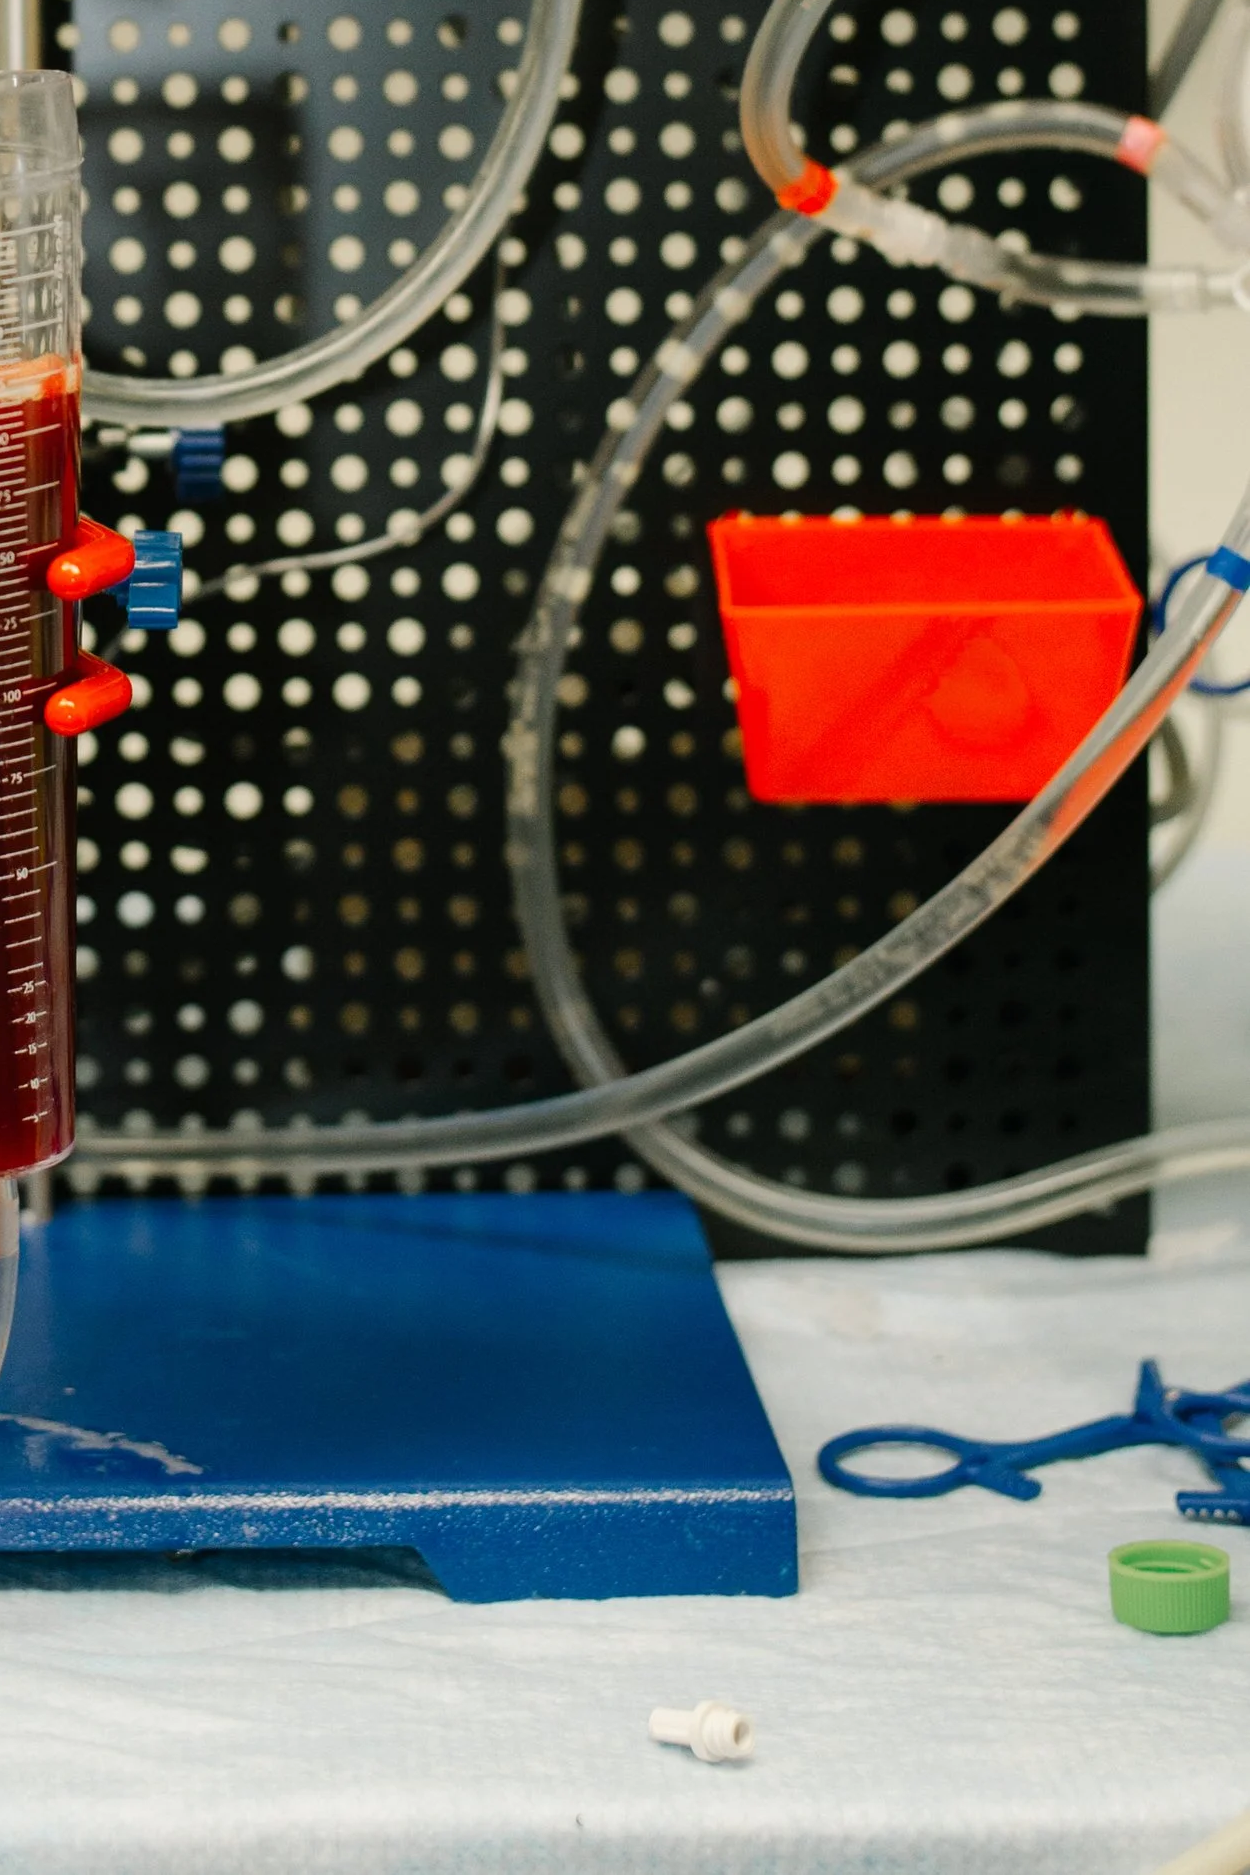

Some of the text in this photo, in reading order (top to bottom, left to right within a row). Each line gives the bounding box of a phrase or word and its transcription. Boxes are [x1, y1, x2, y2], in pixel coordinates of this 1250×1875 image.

[2, 688, 22, 704] 100
[10, 771, 23, 785] 75
[15, 867, 29, 881] 50
[21, 980, 35, 994] 25
[24, 1010, 37, 1025] 20
[27, 1042, 38, 1055] 15
